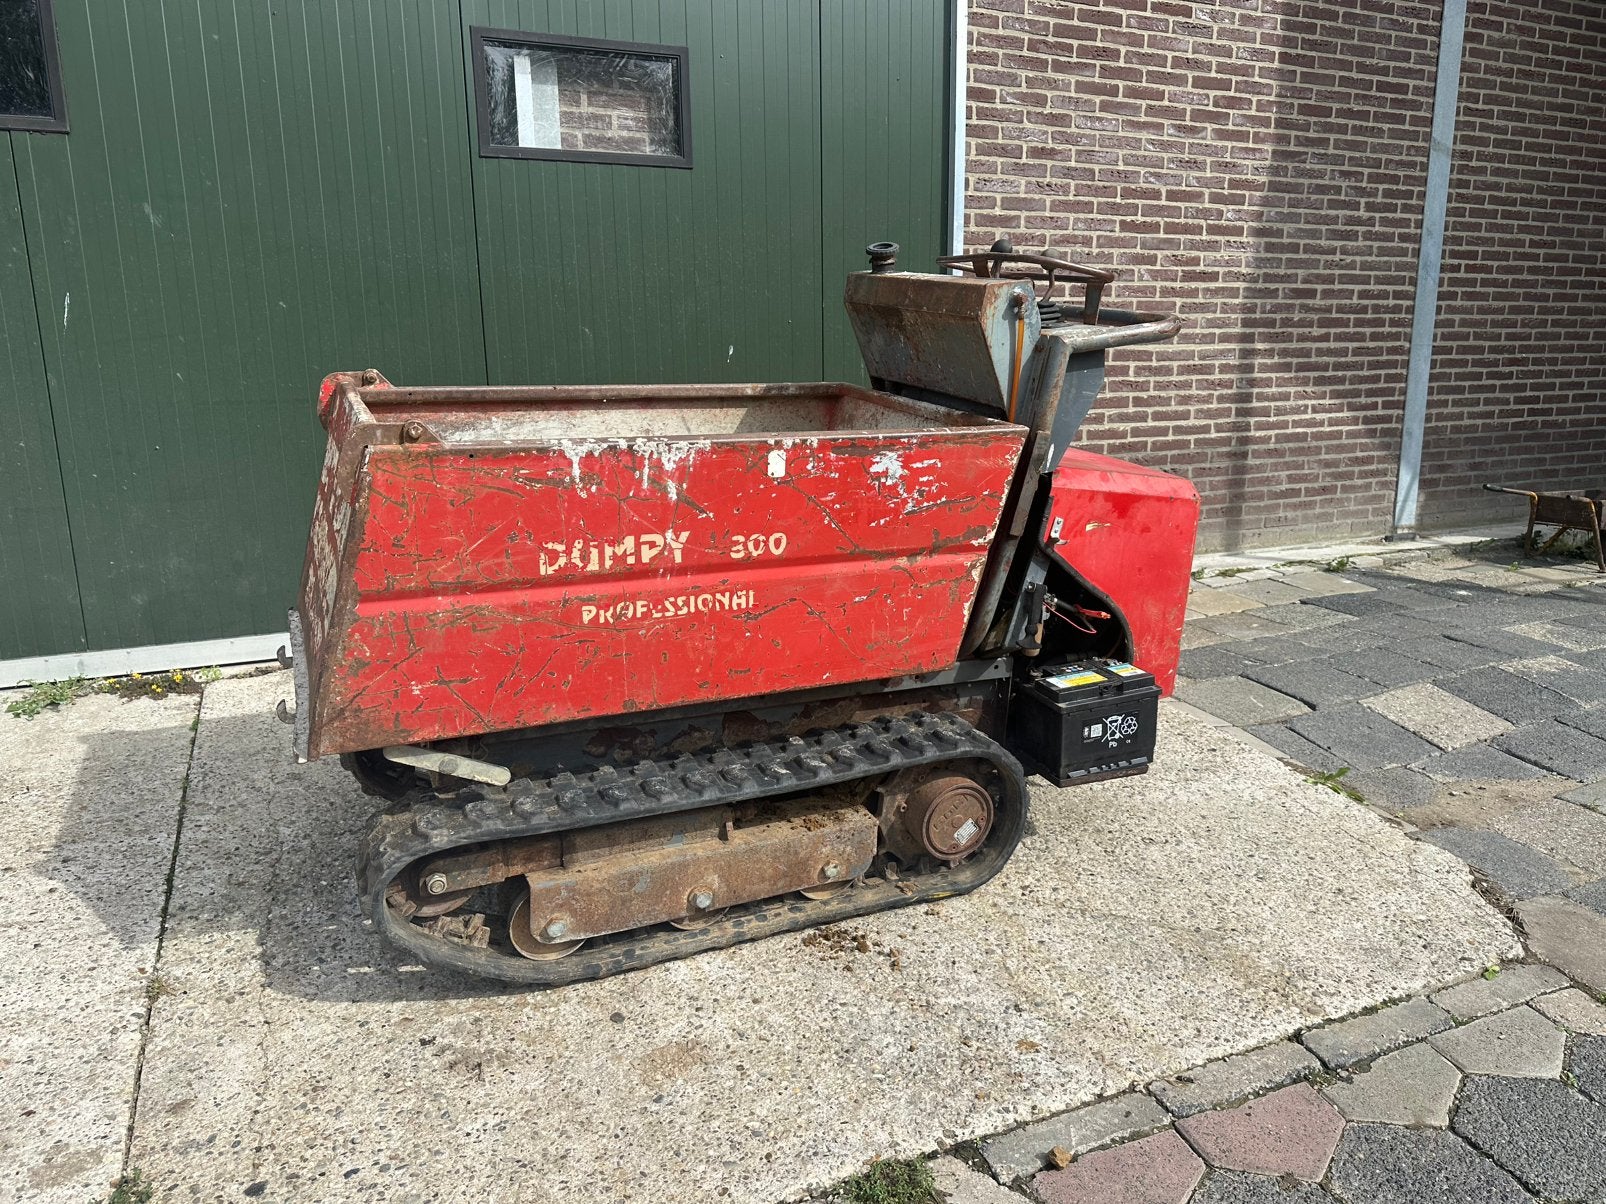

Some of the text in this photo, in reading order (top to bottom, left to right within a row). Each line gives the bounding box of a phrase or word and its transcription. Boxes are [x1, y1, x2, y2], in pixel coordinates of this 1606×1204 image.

[539, 530, 787, 576] DUMPY 300
[1108, 741, 1118, 749] Pb
